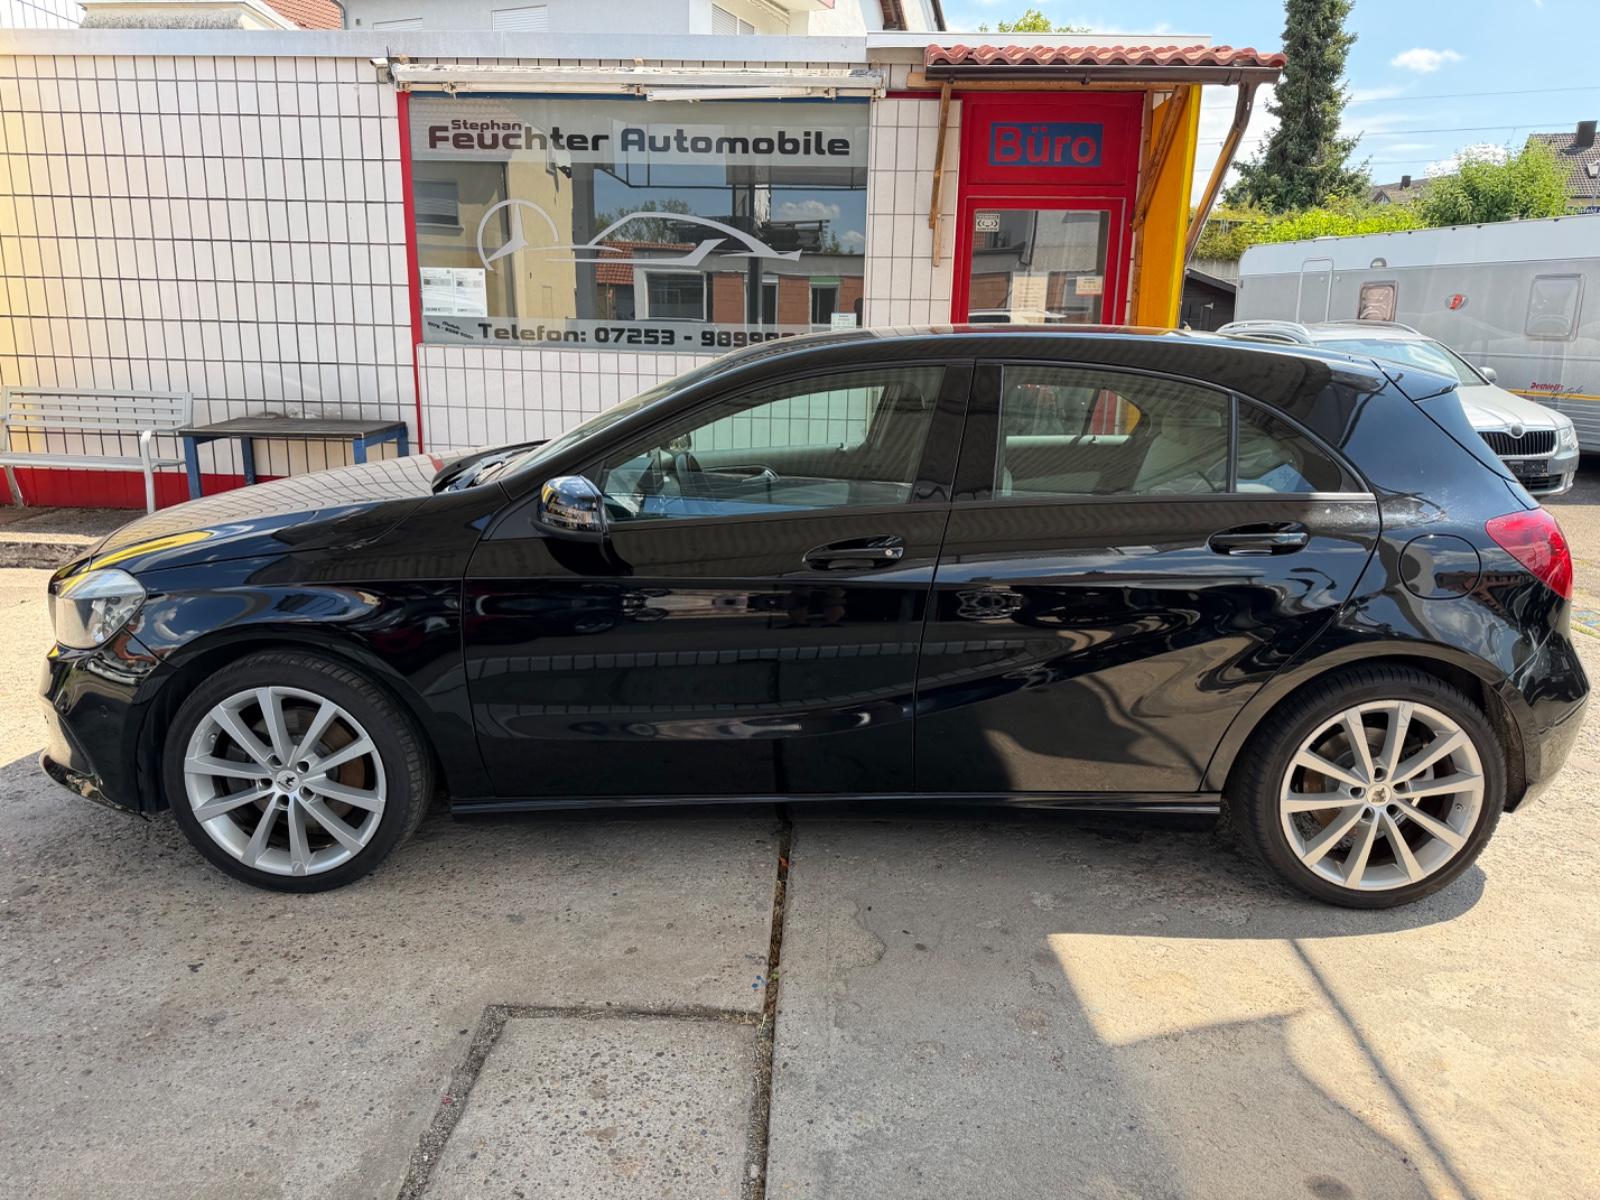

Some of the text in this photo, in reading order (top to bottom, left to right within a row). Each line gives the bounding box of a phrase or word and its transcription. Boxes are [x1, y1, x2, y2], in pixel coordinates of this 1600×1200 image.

[451, 119, 522, 132] Stephan
[428, 125, 850, 156] Feuchter Automobile
[993, 126, 1097, 163] Büro
[477, 322, 586, 343] Telefon:
[594, 326, 676, 345] 07253
